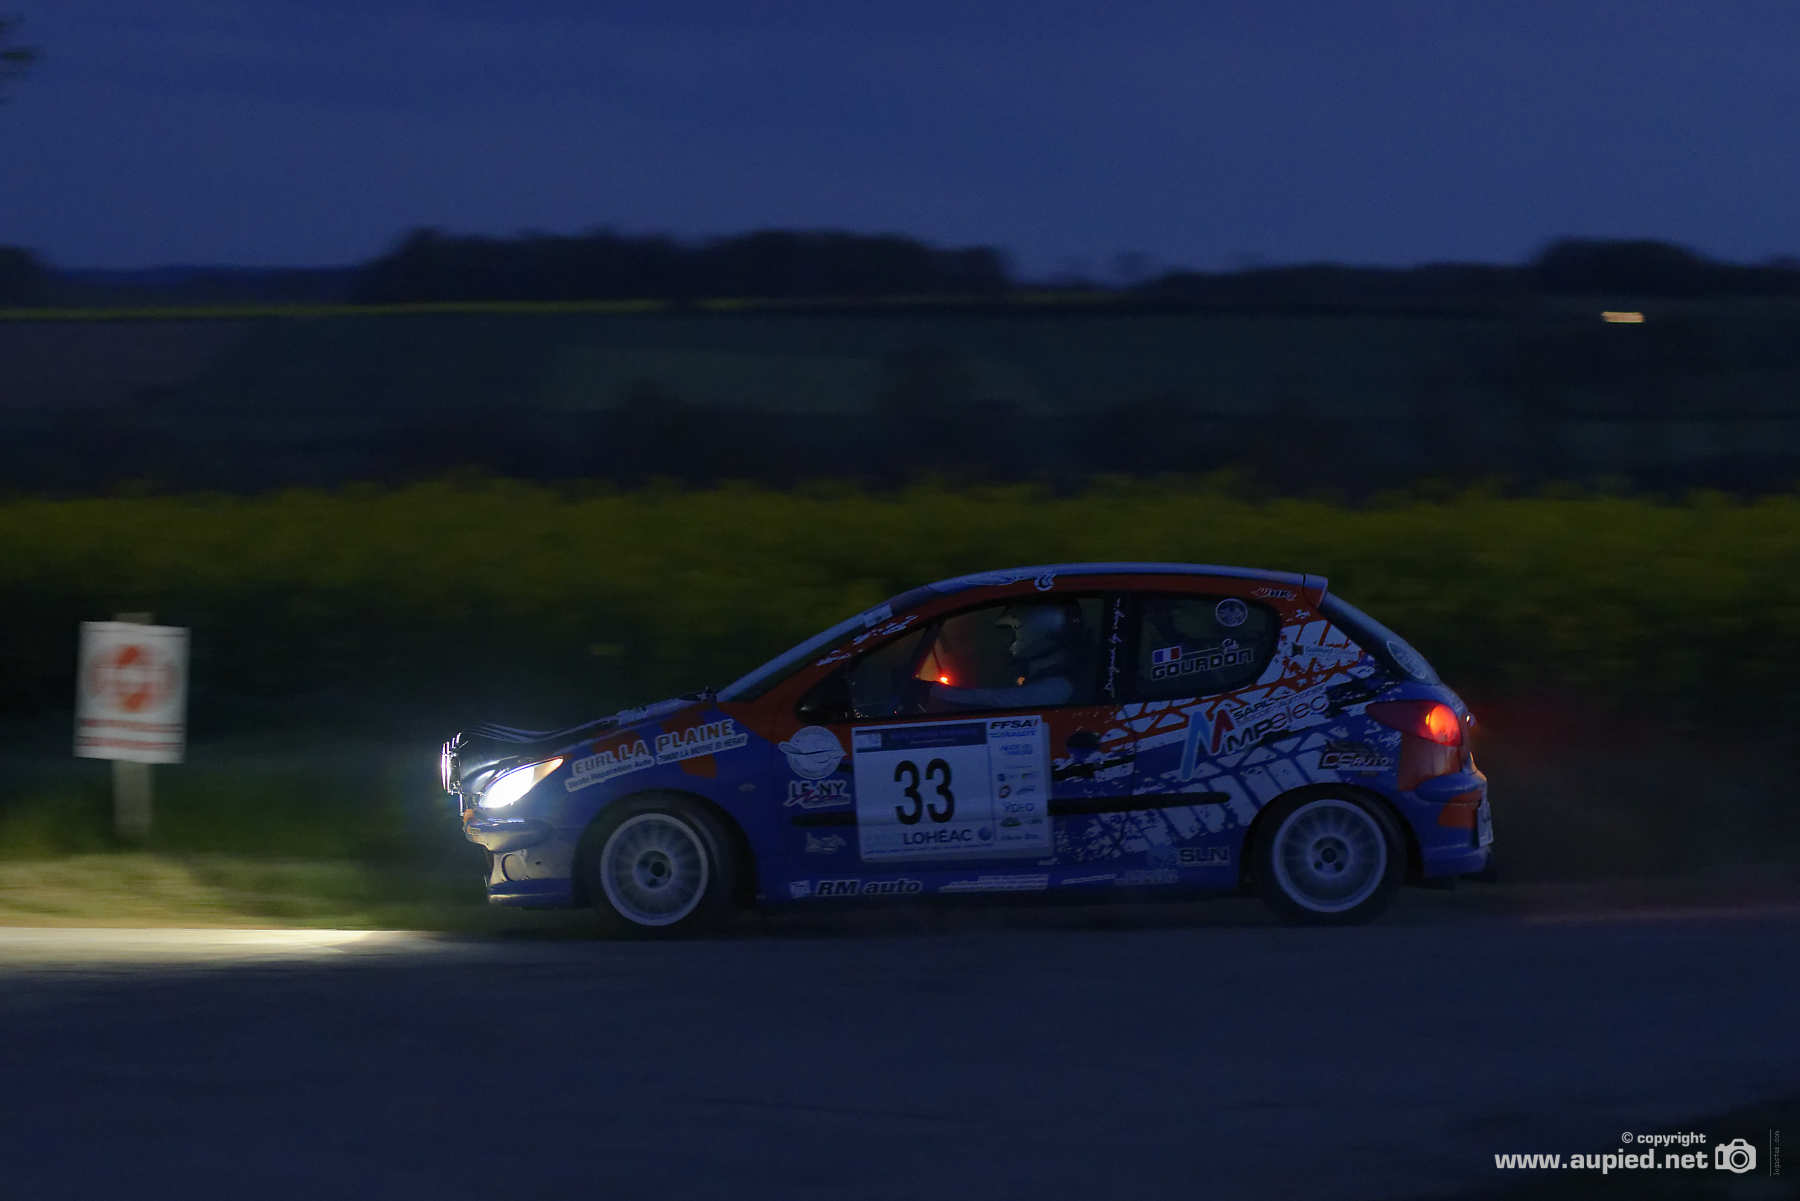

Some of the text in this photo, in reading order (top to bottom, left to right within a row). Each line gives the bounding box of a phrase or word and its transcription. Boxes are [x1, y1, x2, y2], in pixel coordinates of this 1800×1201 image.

[1151, 648, 1254, 680] GOURDON
[990, 719, 1033, 729] FFSA
[575, 751, 616, 774] EURL
[618, 741, 650, 761] LA
[657, 721, 734, 752] PLAINE
[894, 758, 955, 825] 33
[1180, 847, 1229, 863] SLN
[817, 880, 859, 896] RM
[864, 878, 922, 895] auto
